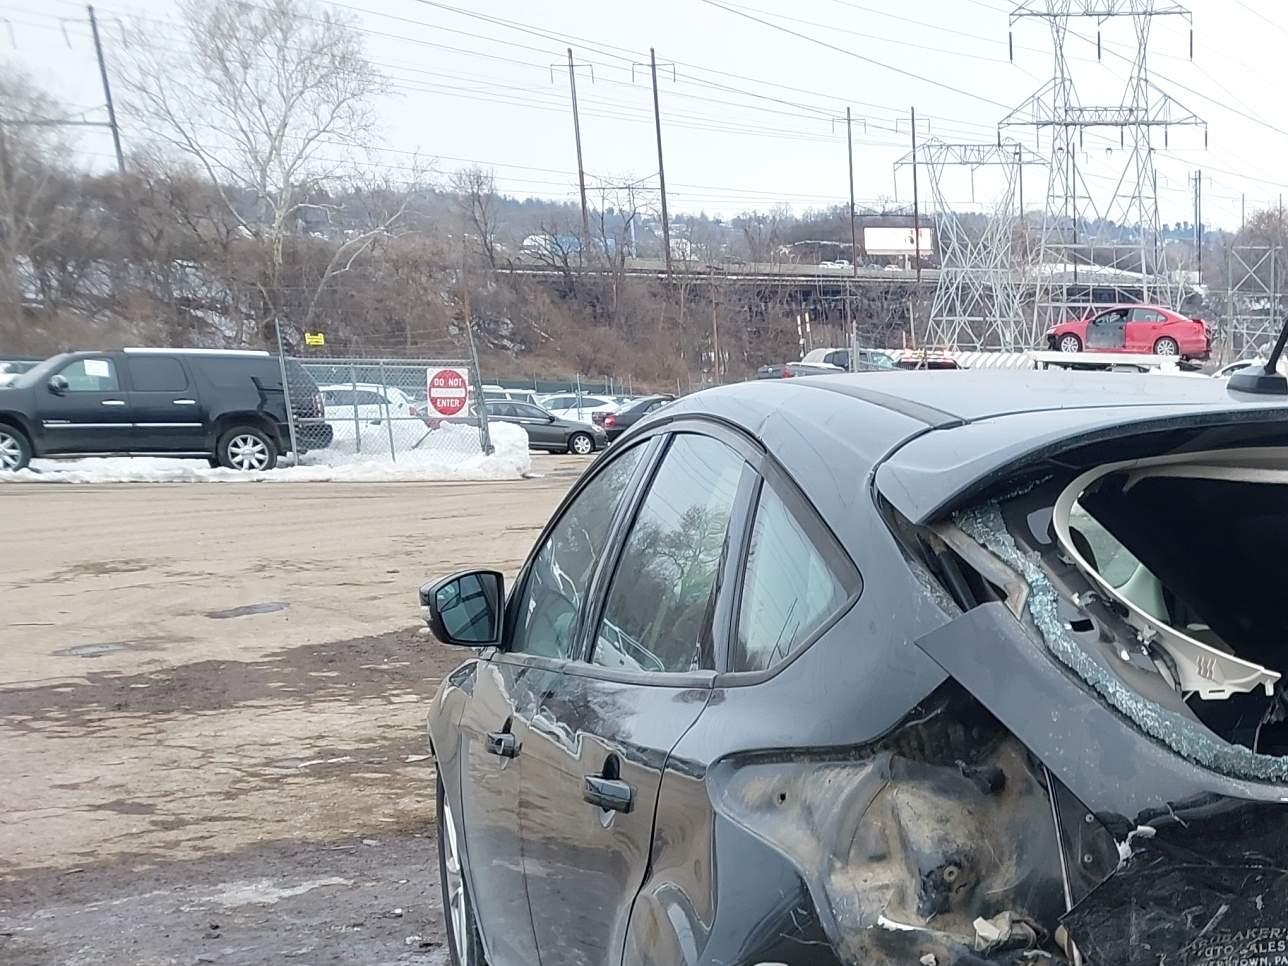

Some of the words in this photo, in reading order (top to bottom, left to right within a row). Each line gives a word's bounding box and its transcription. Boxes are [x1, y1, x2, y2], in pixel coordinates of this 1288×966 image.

[434, 378, 445, 387] DO
[448, 377, 462, 387] NOT
[436, 398, 460, 407] ENTER
[1274, 955, 1288, 966] PA
